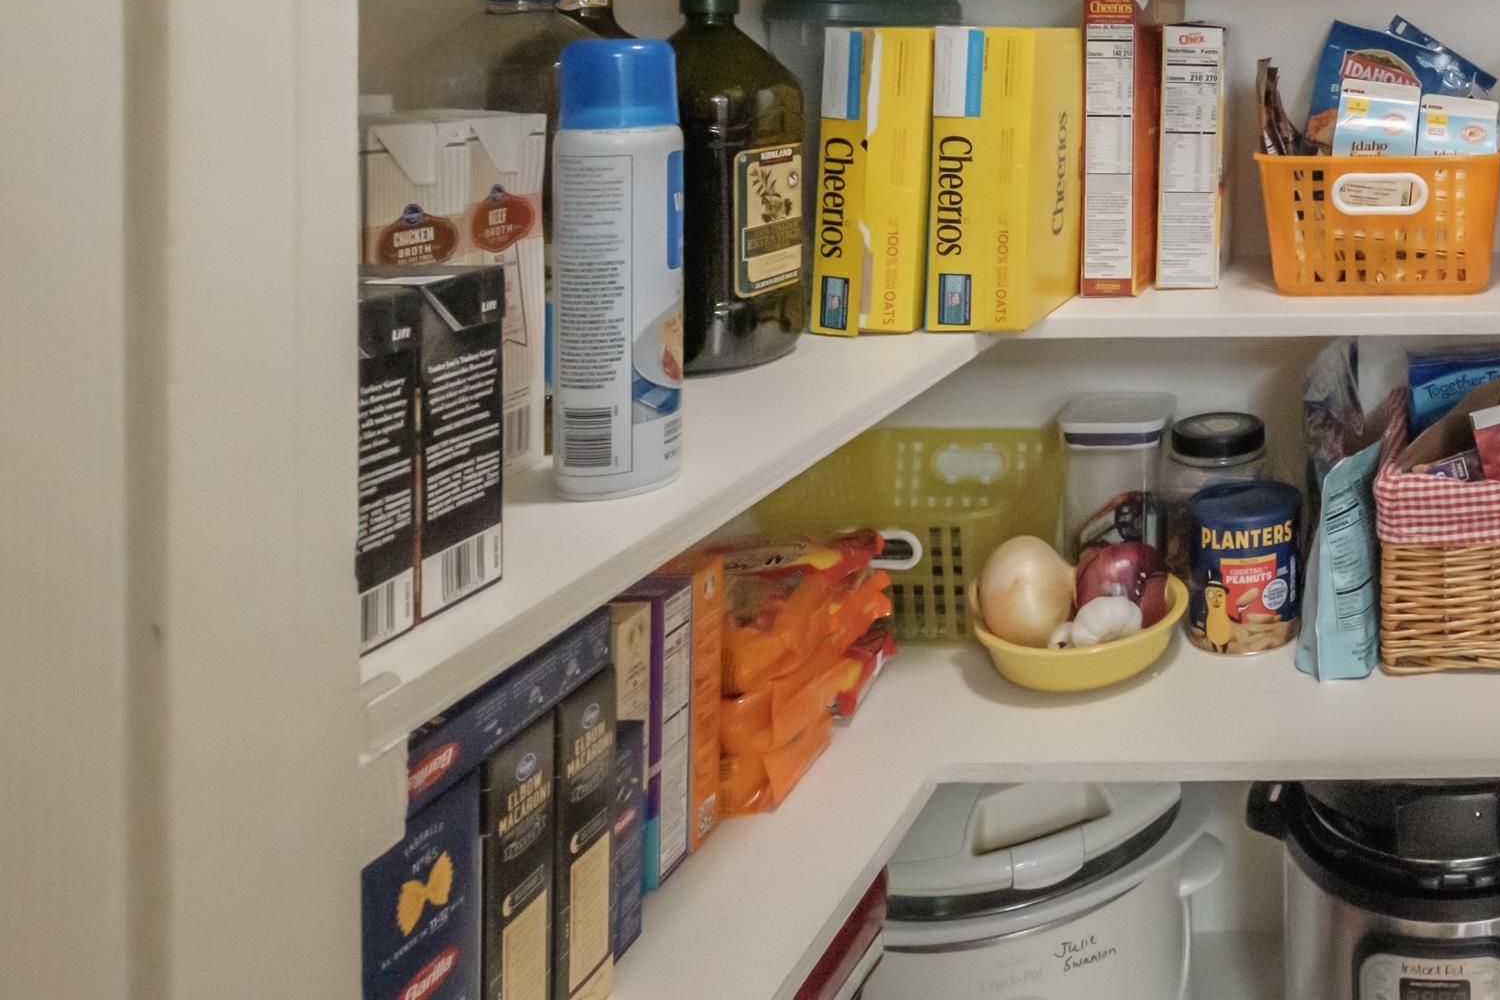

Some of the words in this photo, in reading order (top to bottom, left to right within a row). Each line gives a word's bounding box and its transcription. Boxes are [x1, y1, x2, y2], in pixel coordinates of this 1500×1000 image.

[1089, 0, 1133, 14] Cheerios
[1178, 34, 1206, 45] Chex
[1205, 74, 1218, 82] 270
[760, 148, 793, 160] KIRKLAND
[1351, 140, 1389, 152] Idaho
[1052, 110, 1069, 237] Cheerios
[819, 136, 855, 259] Cheerios
[936, 134, 973, 258] Cheerios
[488, 208, 507, 226] BEEF
[393, 227, 435, 247] CHICKEN
[886, 229, 900, 266] 100%
[397, 245, 433, 259] BROTH
[882, 290, 897, 326] OATS
[994, 289, 1007, 323] OATS
[1423, 373, 1487, 401] Together
[1201, 519, 1293, 550] PLANTERS
[1225, 571, 1272, 585] PEANUTS
[1230, 567, 1264, 576] COCKTAIL
[575, 719, 606, 755] ELBOW
[567, 729, 614, 779] MACARONI
[508, 769, 544, 812] ELBOW
[499, 781, 550, 839] MACARONI
[1063, 946, 1117, 972] Swanson
[1401, 962, 1440, 976] Instant
[404, 953, 454, 1000] Barilla
